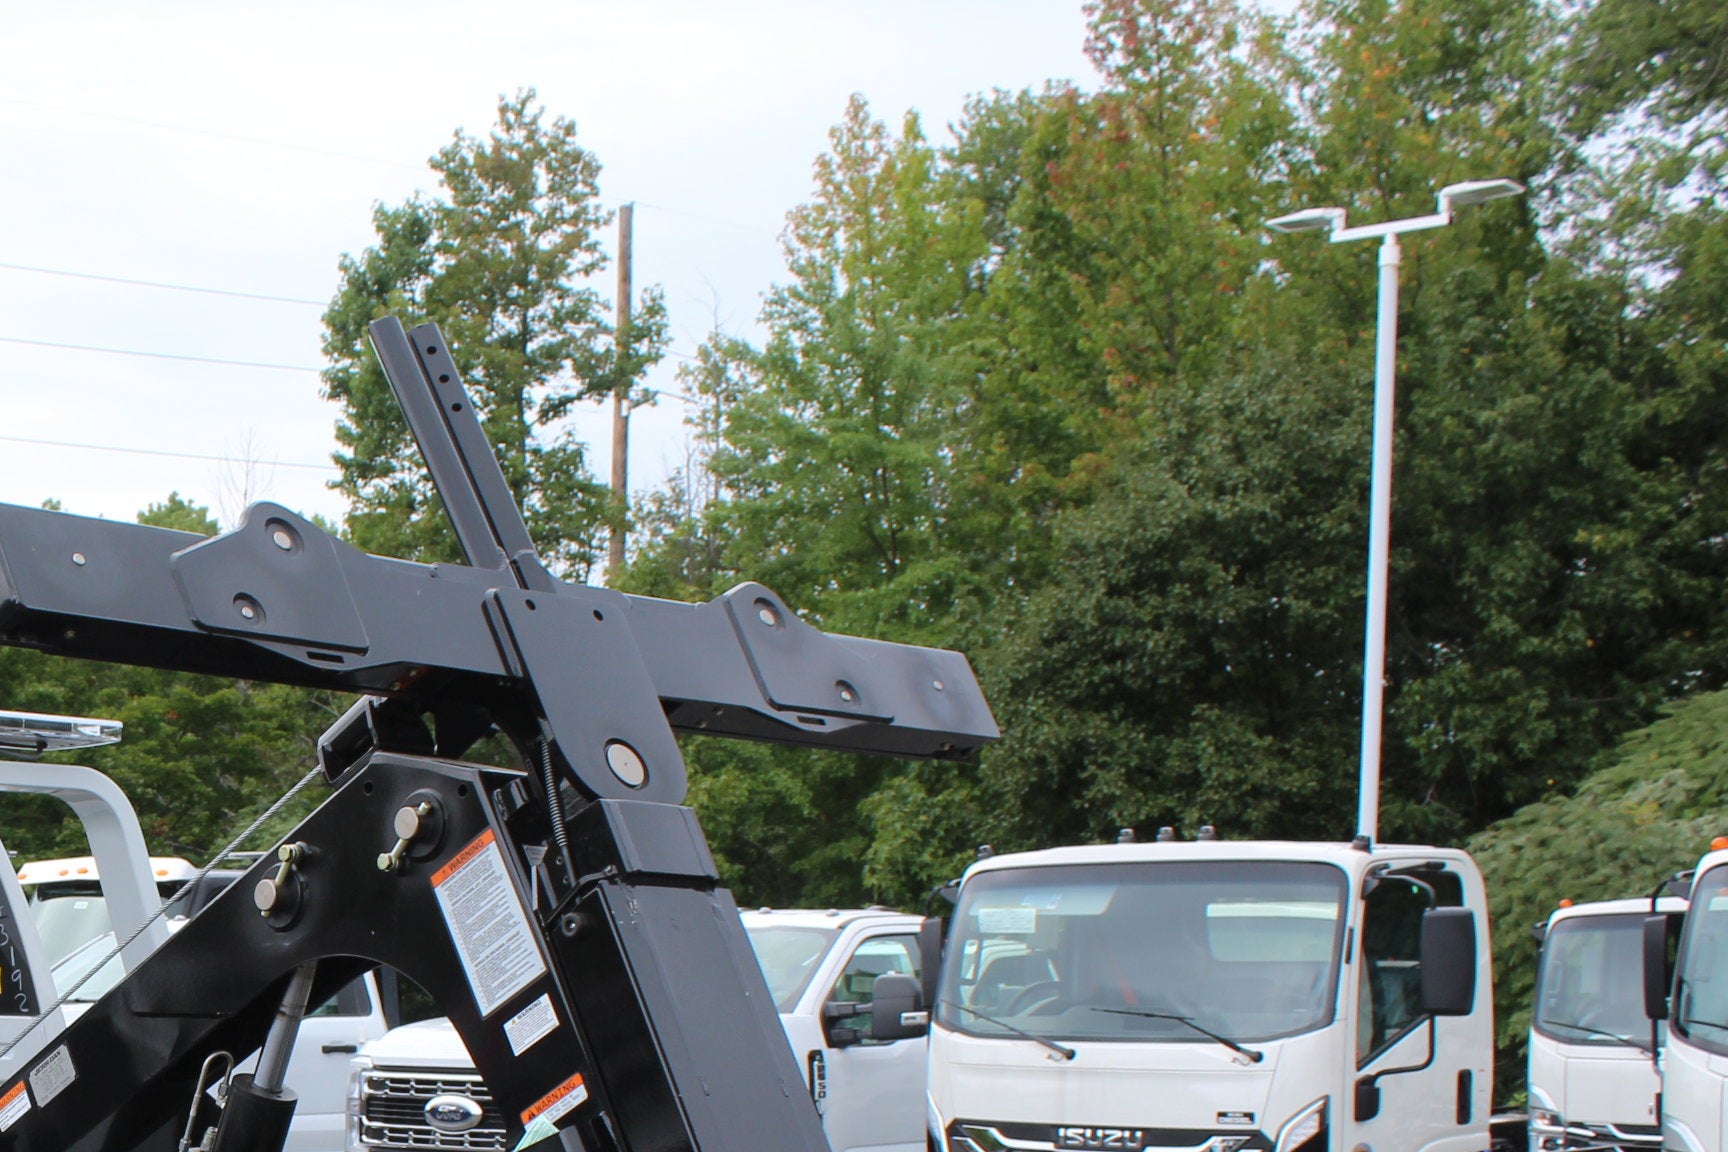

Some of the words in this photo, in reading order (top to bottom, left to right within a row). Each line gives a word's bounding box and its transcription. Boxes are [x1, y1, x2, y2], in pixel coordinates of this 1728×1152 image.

[448, 838, 485, 872] WARNING
[535, 1079, 577, 1115] WARNING
[1057, 1127, 1143, 1148] ISUZU
